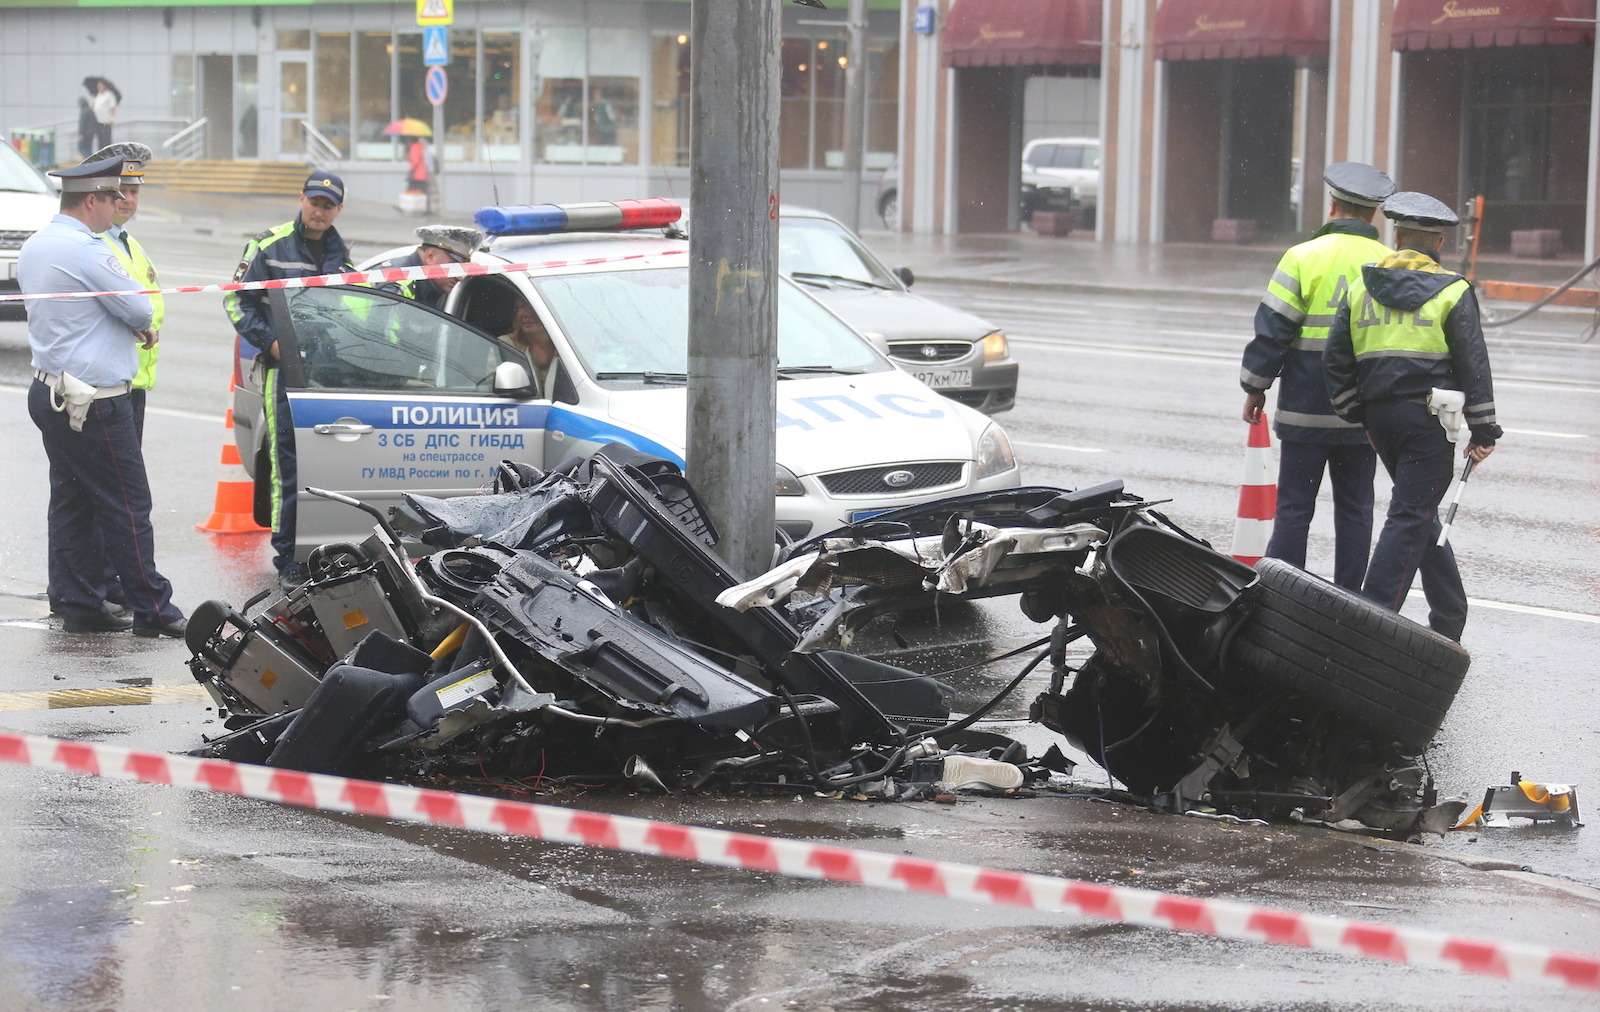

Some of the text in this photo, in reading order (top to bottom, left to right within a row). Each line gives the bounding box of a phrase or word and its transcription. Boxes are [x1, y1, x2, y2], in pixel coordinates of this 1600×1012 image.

[391, 406, 519, 429] ПОЛИЦИЯ
[393, 434, 415, 447] СБ
[425, 434, 460, 449] ДПС
[470, 434, 525, 449] ГИБДД
[403, 453, 485, 463] на спецтрассе
[362, 468, 375, 479] ГУ
[378, 468, 405, 480] МВД
[409, 468, 450, 479] России
[455, 469, 470, 479] по
